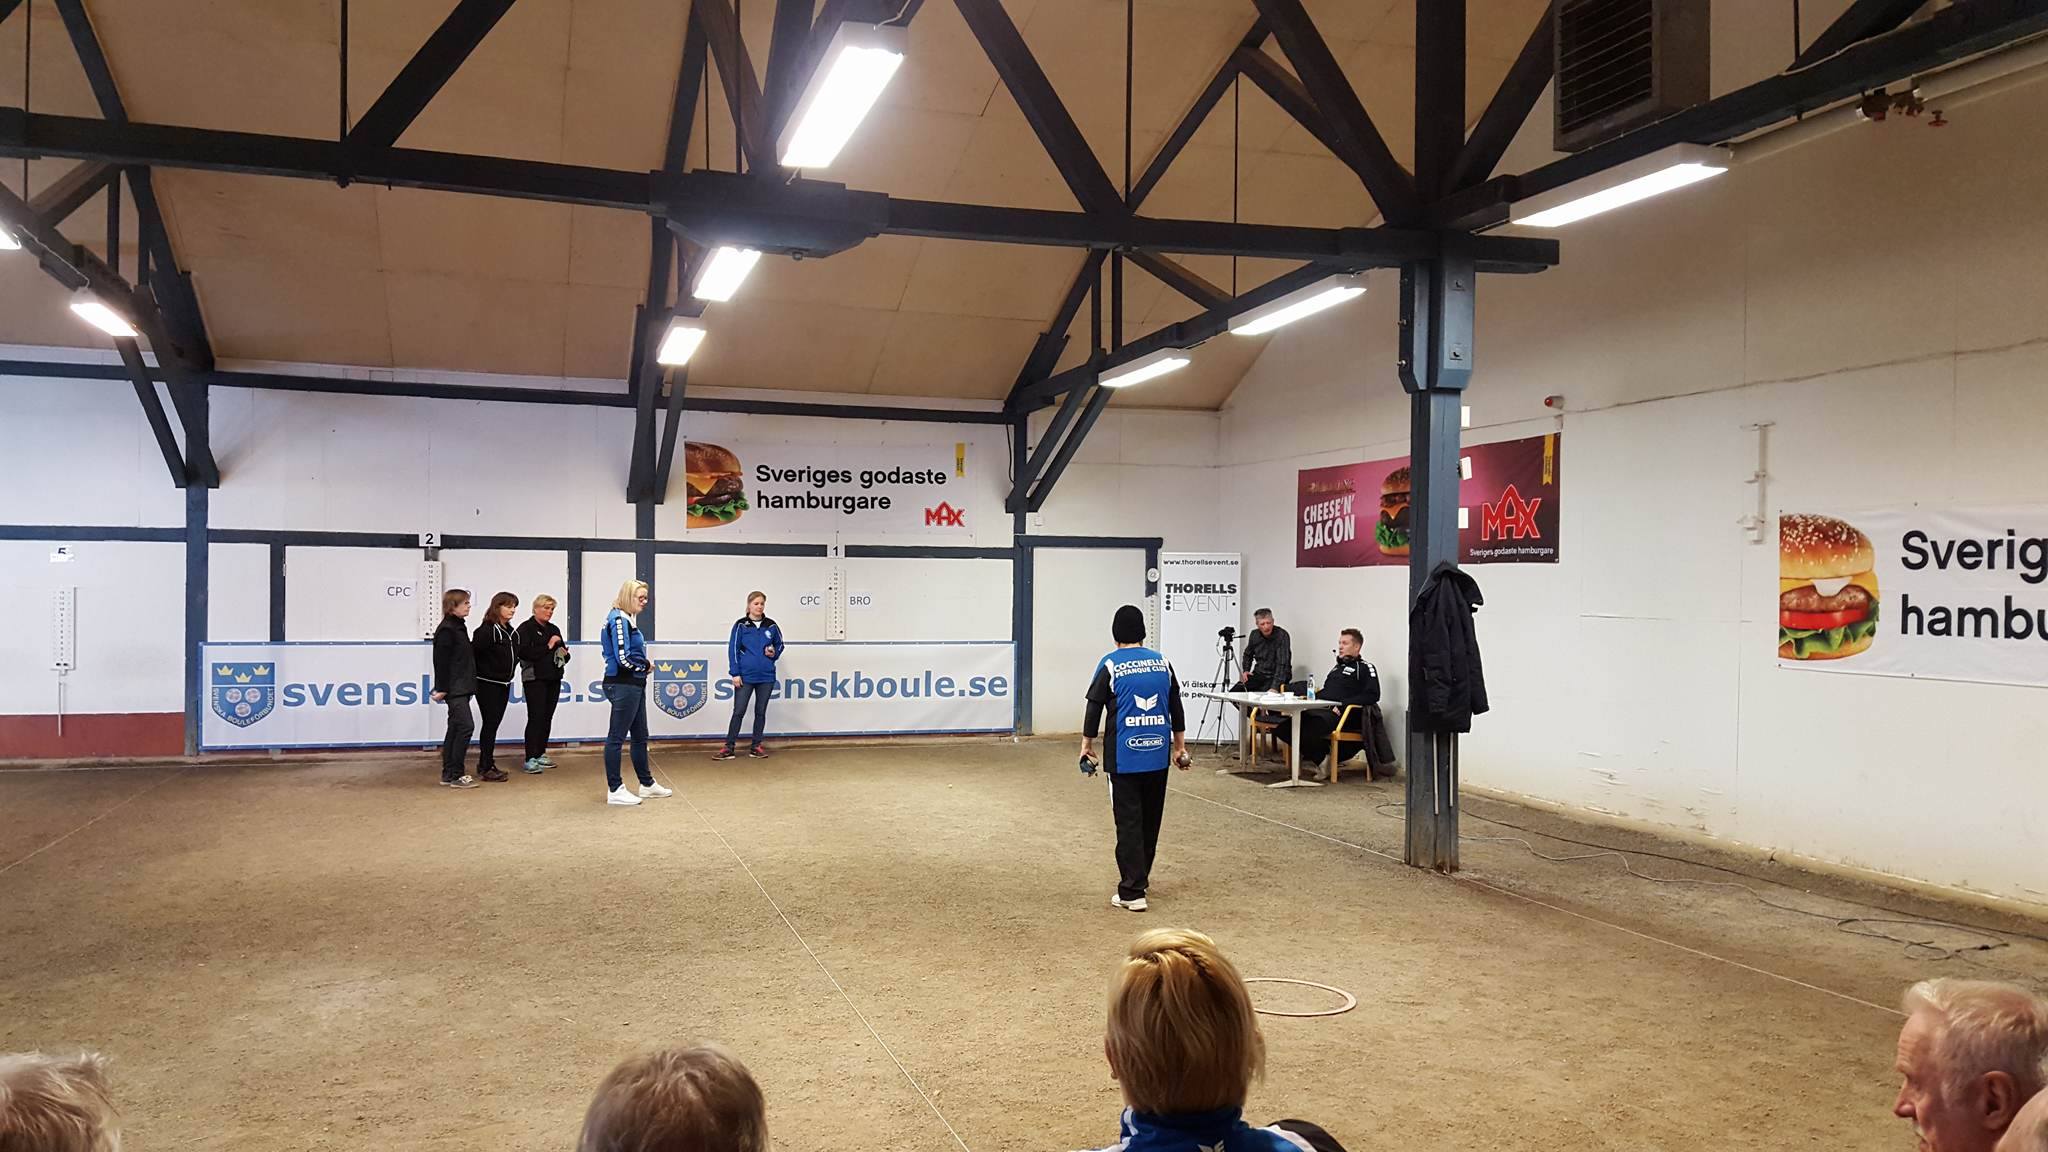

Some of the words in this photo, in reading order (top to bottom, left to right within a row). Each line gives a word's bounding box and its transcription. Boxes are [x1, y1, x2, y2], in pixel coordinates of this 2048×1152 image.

[756, 464, 852, 487] Sveriges
[859, 466, 947, 488] godaste
[757, 490, 891, 515] hamburgare
[925, 501, 964, 528] MAX
[1481, 484, 1541, 541] MAX
[1304, 514, 1355, 550] BACON
[425, 533, 434, 545] 2
[833, 546, 839, 556] 1
[1470, 548, 1493, 558] Sveriges
[1494, 547, 1517, 557] godaste
[1518, 546, 1554, 556] hamburgare
[387, 586, 411, 597] CPC
[1165, 583, 1237, 594] THORELLS
[800, 596, 820, 605] CPC
[850, 596, 871, 606] BRO
[1173, 595, 1232, 612] EVENT
[714, 671, 1008, 701] senskboule.se
[1125, 714, 1165, 727] erima
